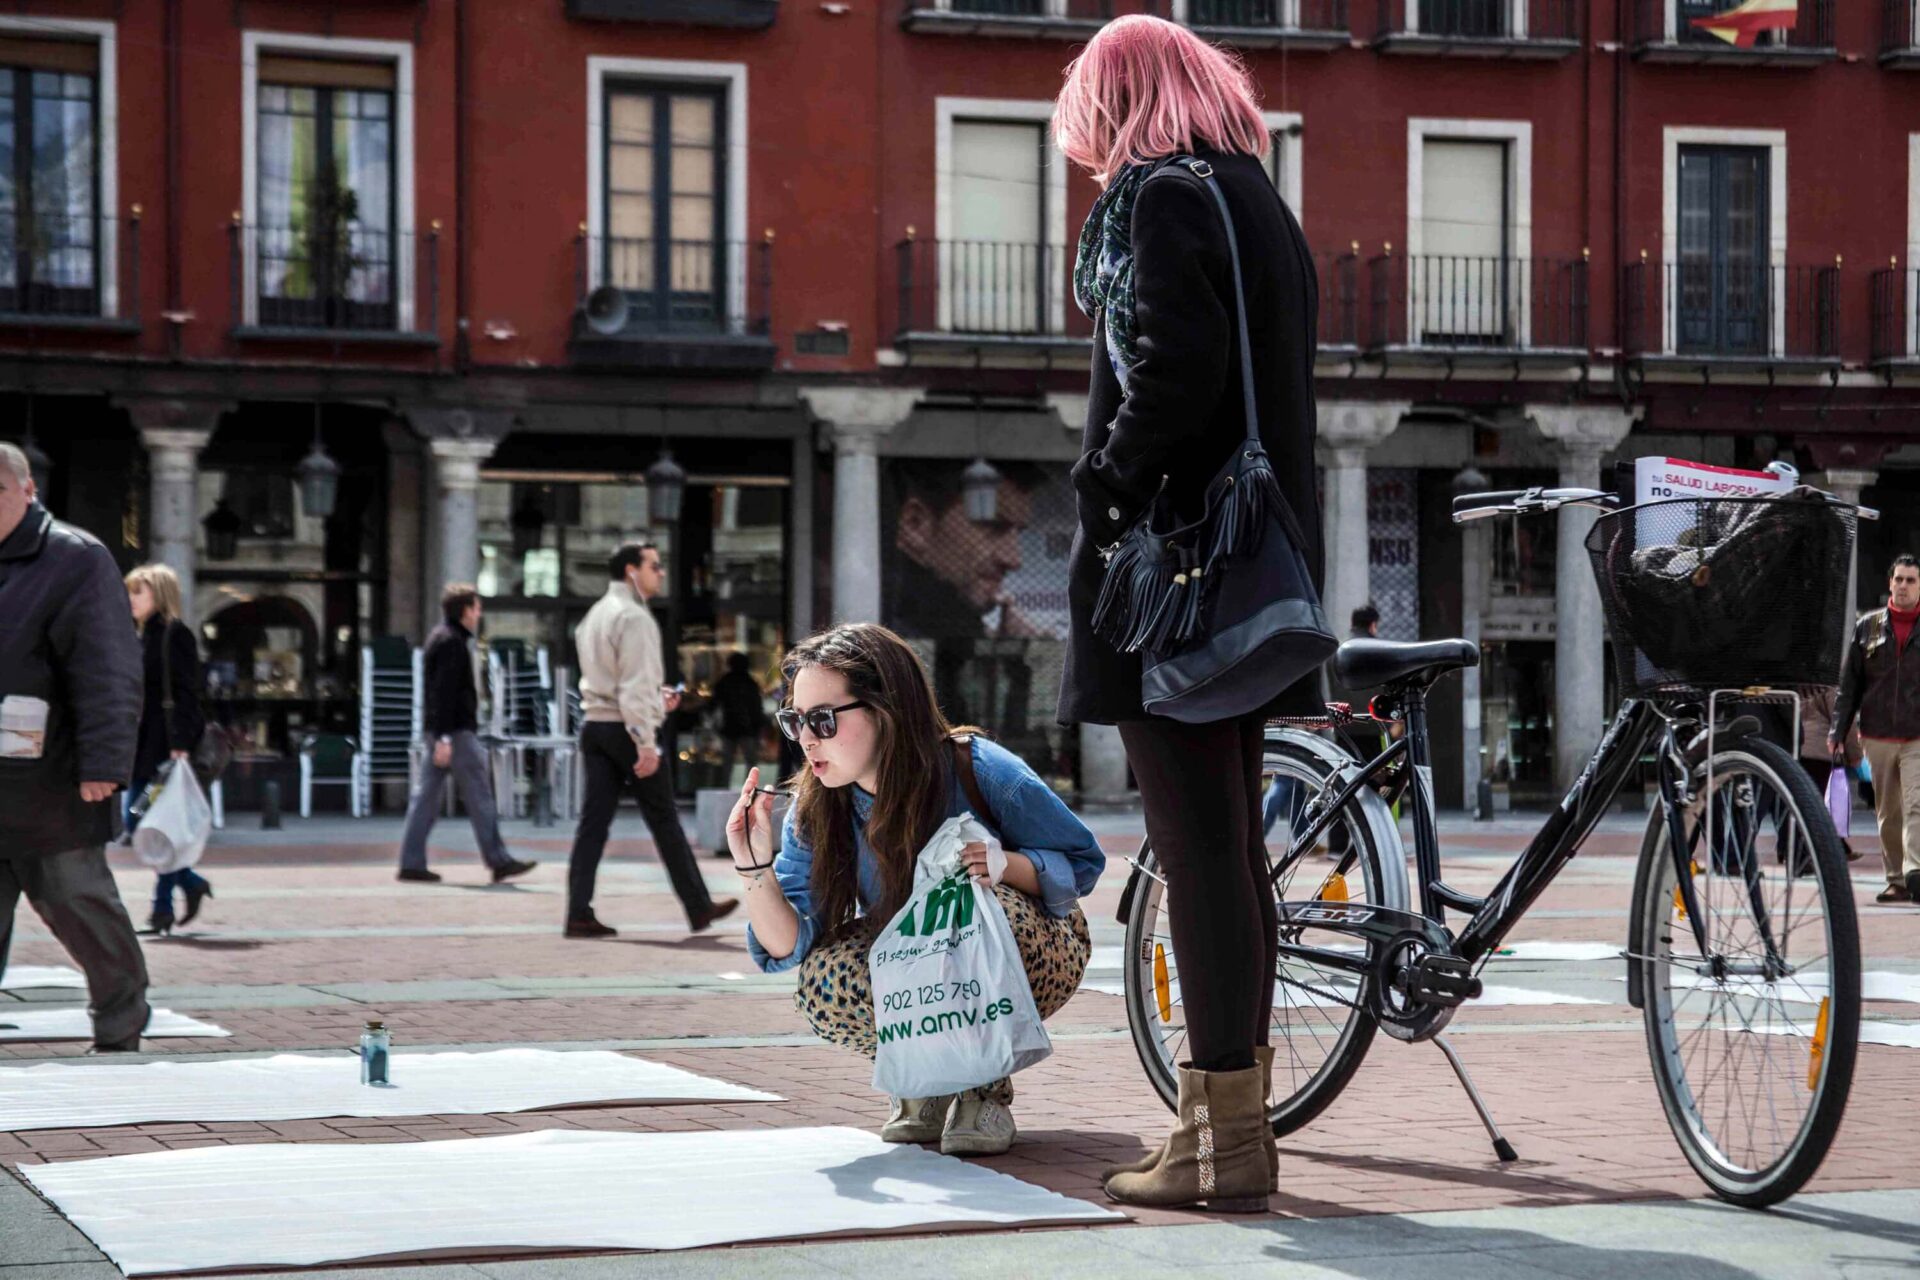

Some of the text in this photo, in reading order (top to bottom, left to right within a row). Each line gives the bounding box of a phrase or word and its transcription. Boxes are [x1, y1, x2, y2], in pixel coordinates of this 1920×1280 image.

[1665, 474, 1703, 488] SALUD
[1651, 487, 1672, 497] no
[1294, 907, 1376, 924] BH
[889, 944, 929, 961] segur
[883, 979, 981, 1013] 902 125 750
